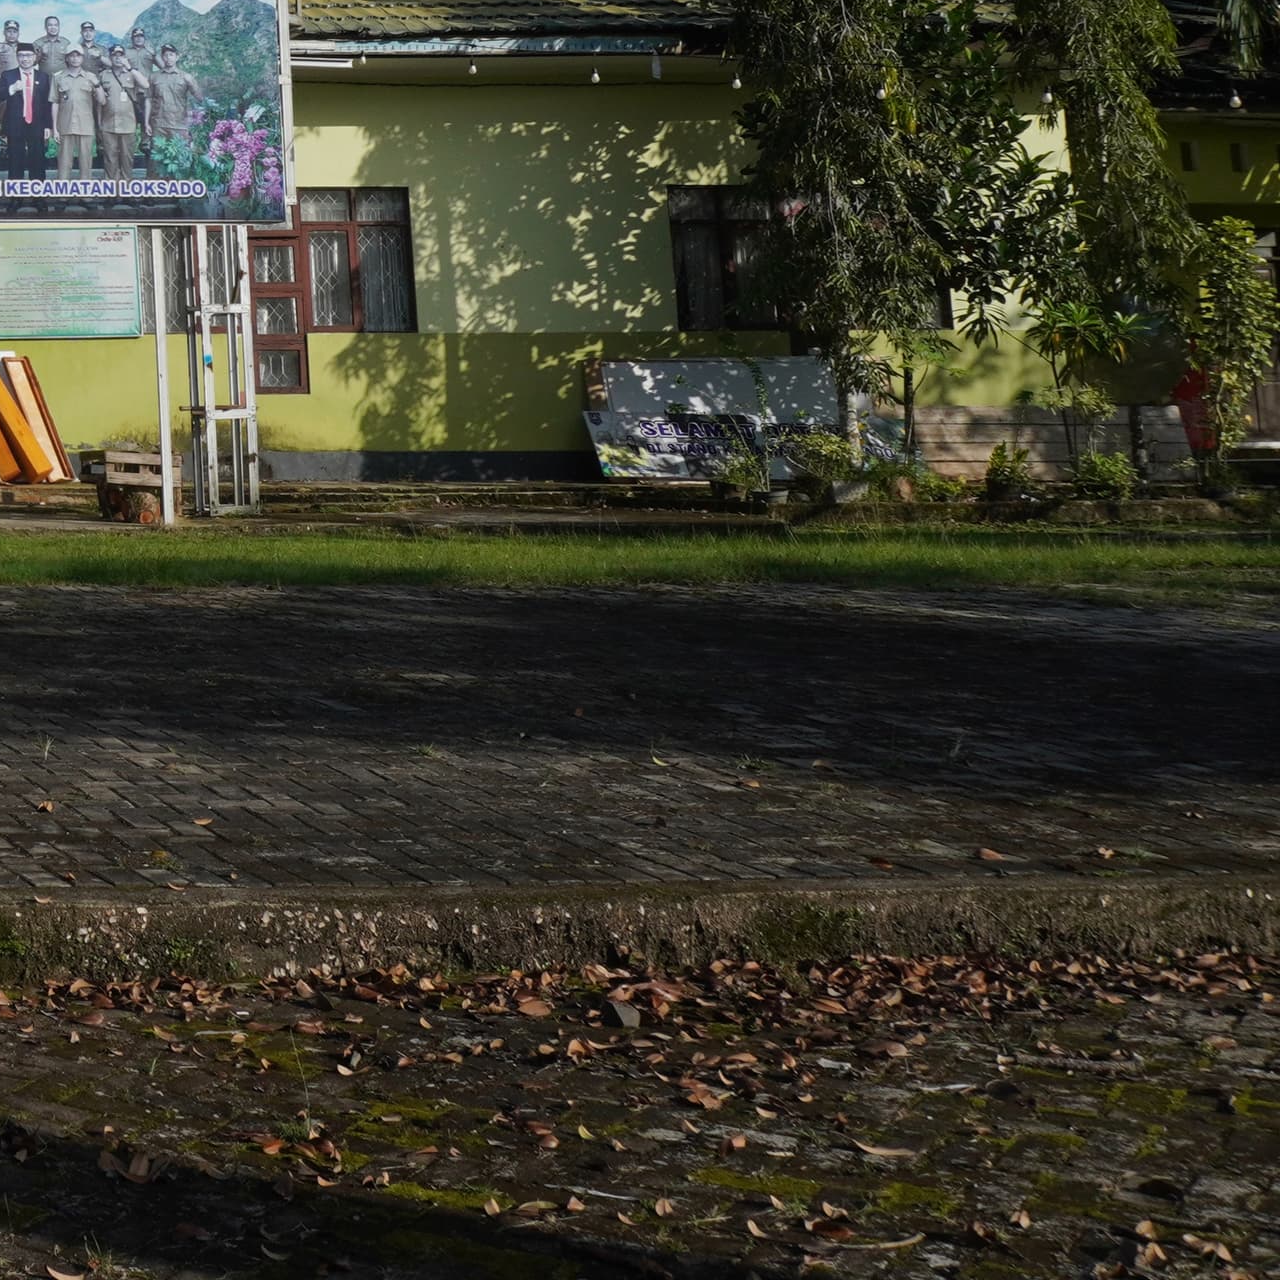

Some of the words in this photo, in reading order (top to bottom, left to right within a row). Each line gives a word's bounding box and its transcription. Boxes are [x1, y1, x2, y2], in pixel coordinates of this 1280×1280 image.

[5, 180, 115, 198] KECAMATAN
[120, 180, 206, 198] LOKSADO
[639, 420, 756, 441] SELAMT
